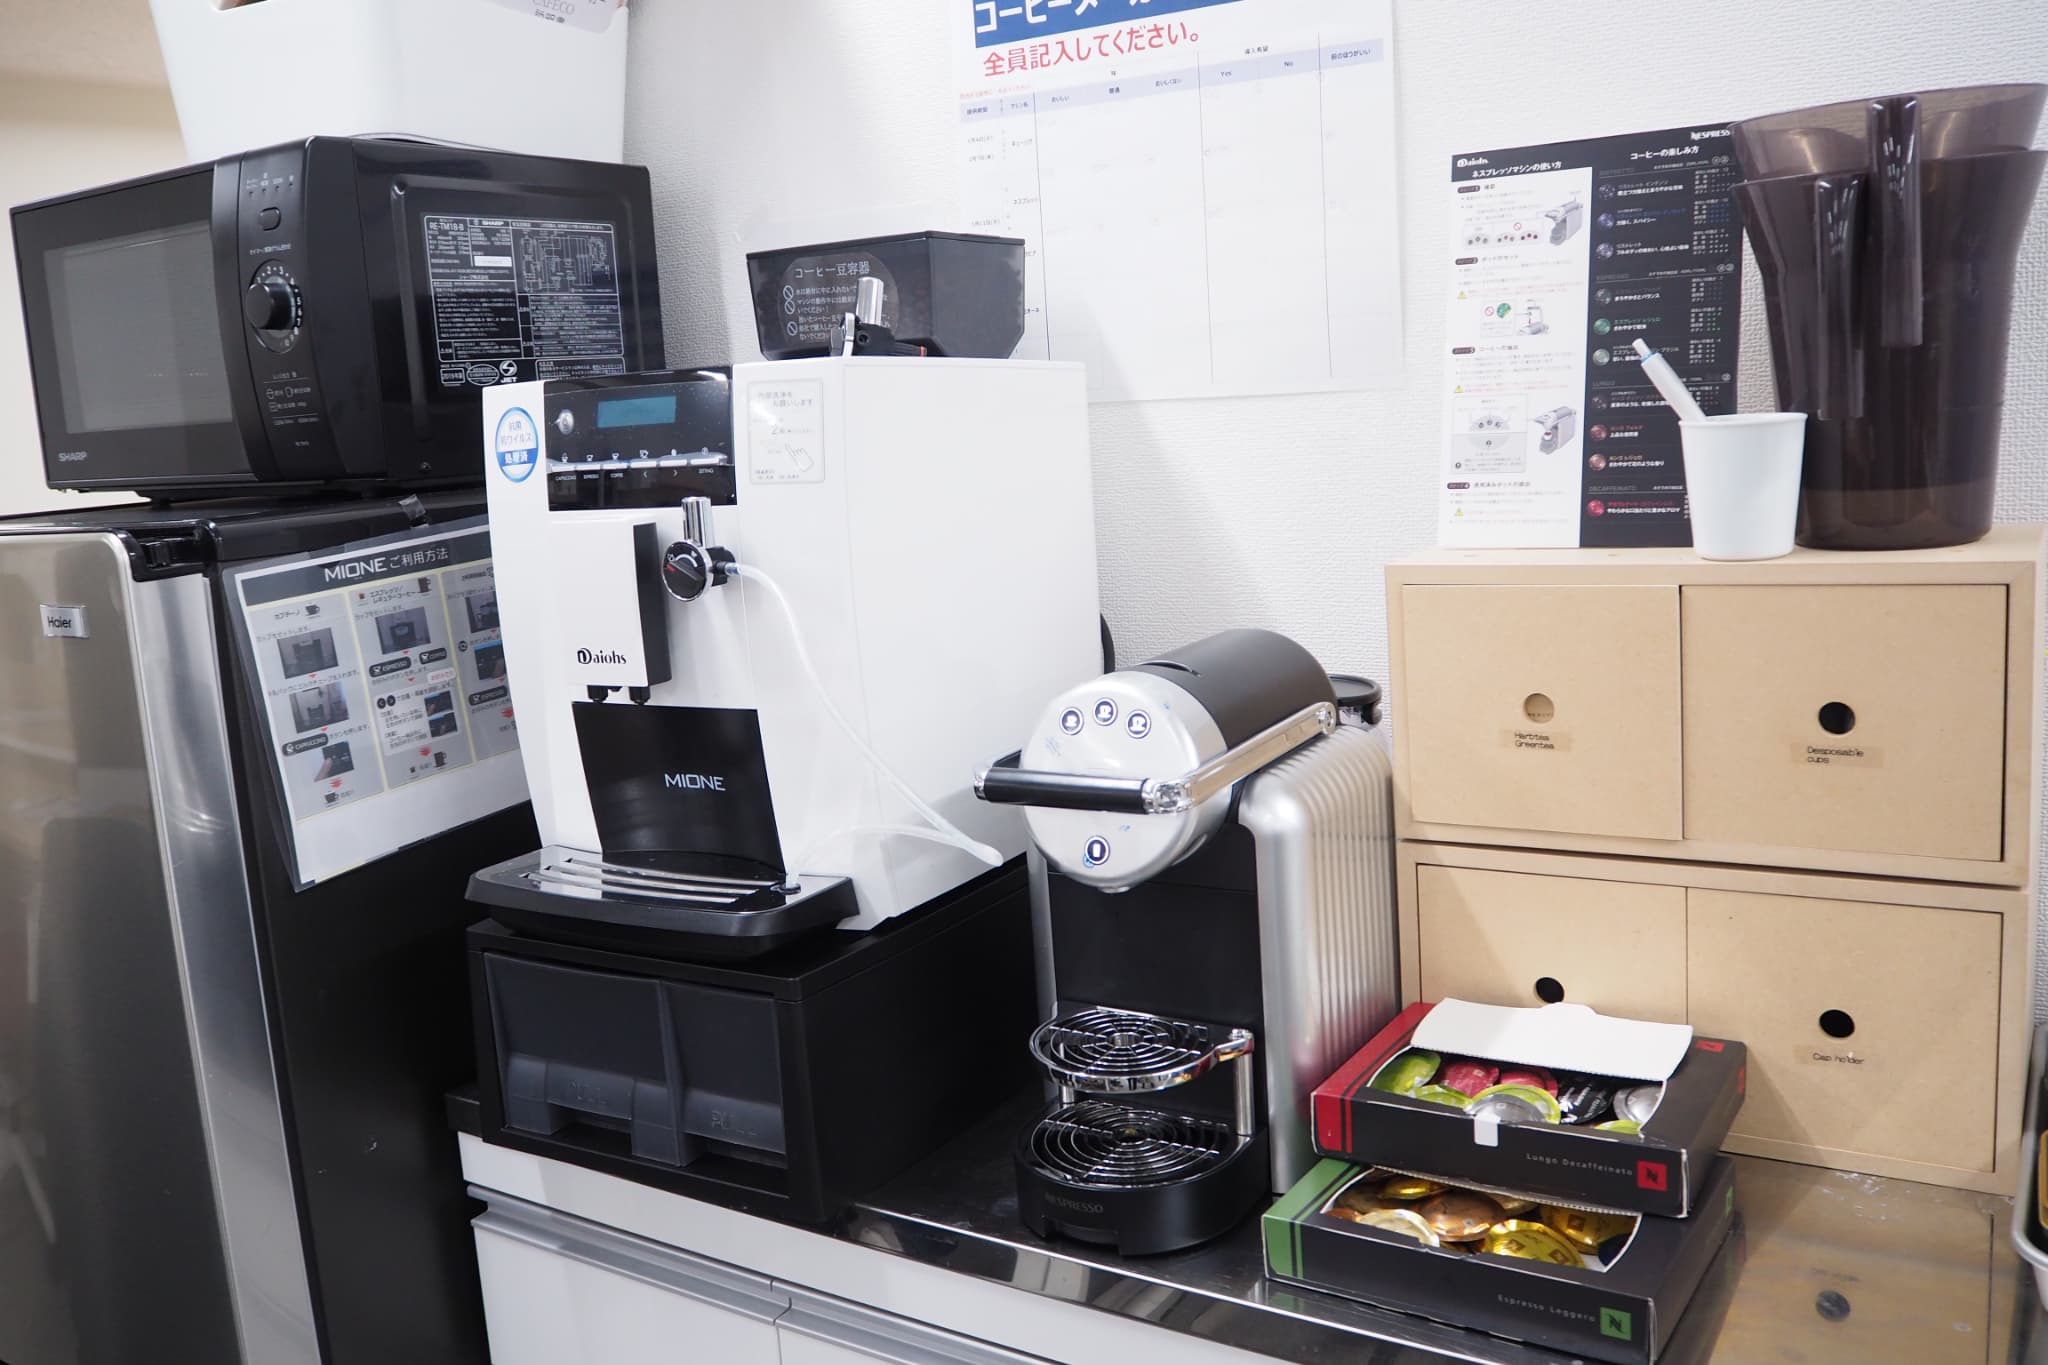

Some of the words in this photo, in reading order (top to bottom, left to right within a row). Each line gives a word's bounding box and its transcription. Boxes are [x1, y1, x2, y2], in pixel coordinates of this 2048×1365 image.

[983, 22, 1200, 77] 全員記入してください。
[1690, 129, 1732, 141] NESPRESS
[1630, 145, 1700, 160] コーヒーの楽しみ方
[1472, 161, 1562, 178] ネスプレッソマシンの使い方
[429, 221, 465, 232] RE-TM18-B
[794, 261, 871, 278] コーヒー豆容器
[58, 452, 88, 462] SHARP
[324, 556, 388, 582] MIONE
[390, 548, 449, 569] ご利用方法
[47, 615, 73, 629] Haier
[577, 648, 627, 664] Daiohs
[664, 773, 727, 792] MIONE
[1526, 1152, 1558, 1165] Lungo
[1562, 1158, 1633, 1176] Decaffeinato
[1497, 1294, 1545, 1311] Espresso
[1550, 1306, 1597, 1322] Leggero
